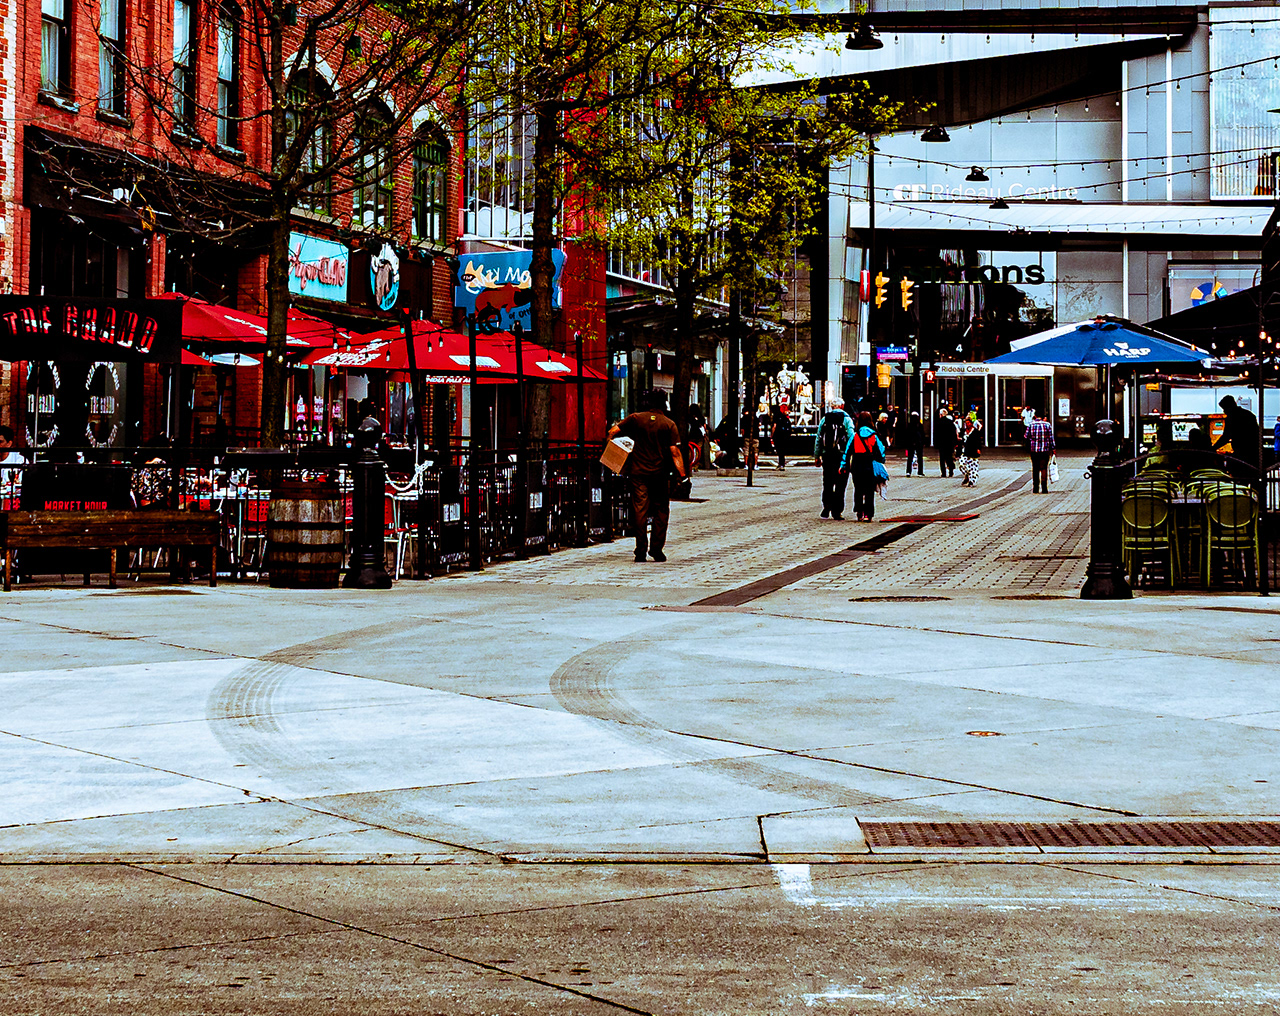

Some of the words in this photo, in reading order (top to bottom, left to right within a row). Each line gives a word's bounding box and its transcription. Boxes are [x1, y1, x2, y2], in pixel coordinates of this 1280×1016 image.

[931, 182, 1001, 201] Rideau
[1008, 182, 1078, 201] Centre
[504, 266, 532, 288] MO
[518, 307, 533, 319] Ott
[2, 304, 52, 335] THE
[62, 302, 158, 354] GRAND
[1103, 348, 1151, 357] HARP
[44, 500, 81, 511] MARKET
[84, 500, 108, 510] HOUR
